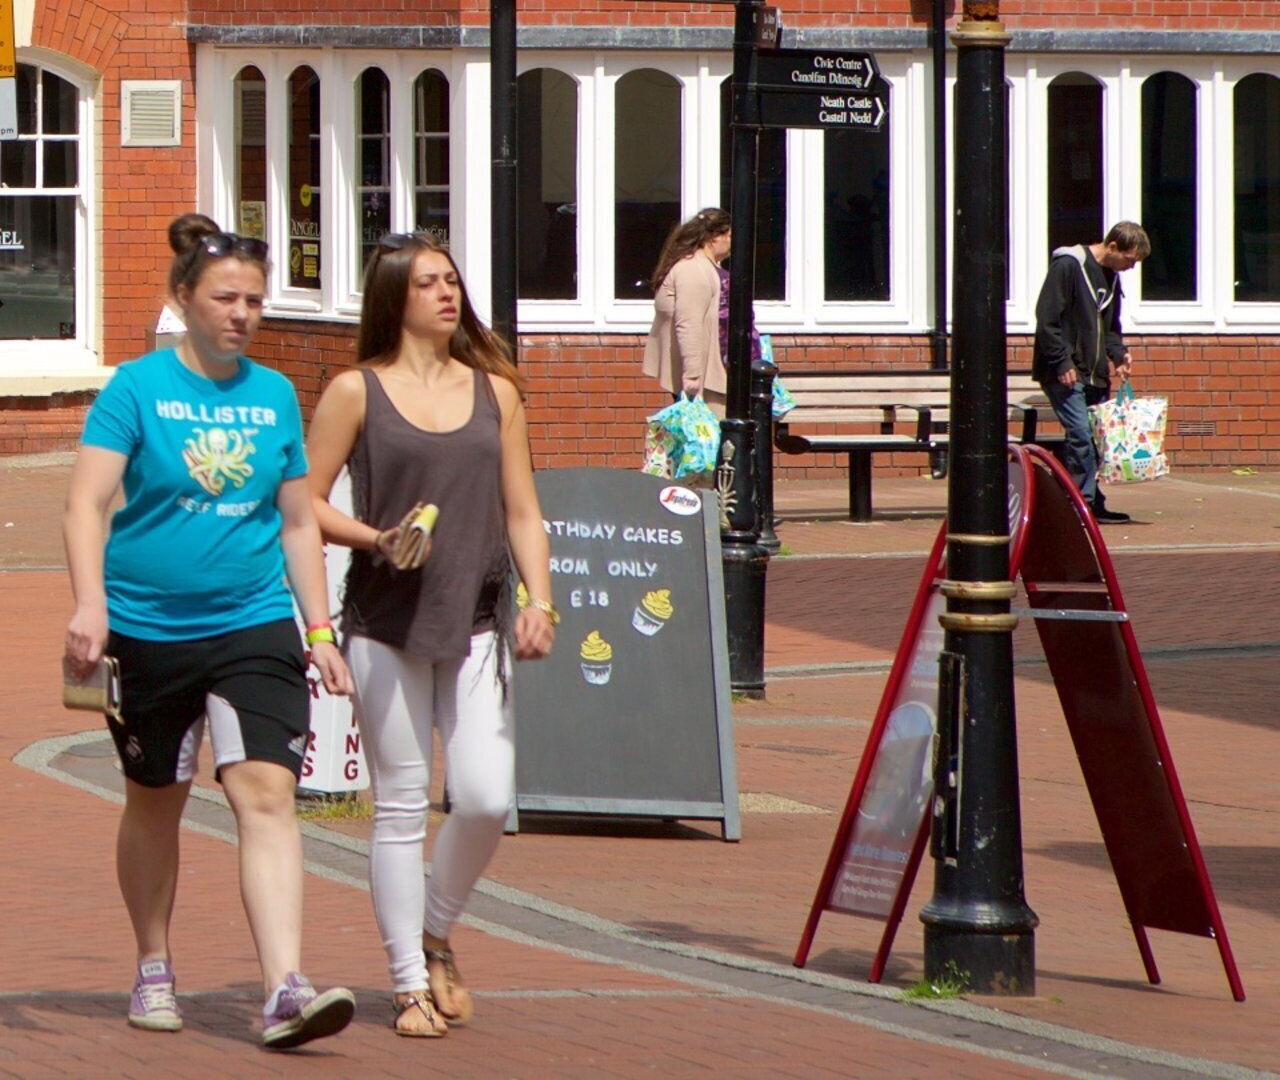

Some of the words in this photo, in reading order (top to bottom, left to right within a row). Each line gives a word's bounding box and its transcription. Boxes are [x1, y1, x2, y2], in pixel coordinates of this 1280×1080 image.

[814, 56, 834, 69] Civic
[836, 57, 862, 70] Centre
[820, 96, 845, 108] Neath
[847, 97, 873, 108] Castle
[819, 110, 847, 123] Castell
[850, 111, 872, 124] Nedd
[1, 127, 14, 135] pm
[291, 219, 320, 237] ANGEL
[155, 399, 277, 427] HOLLISTER
[541, 520, 617, 541] RTHDAY
[623, 526, 684, 546] CAKES
[549, 557, 590, 575] ROM
[607, 560, 658, 579] ONLY
